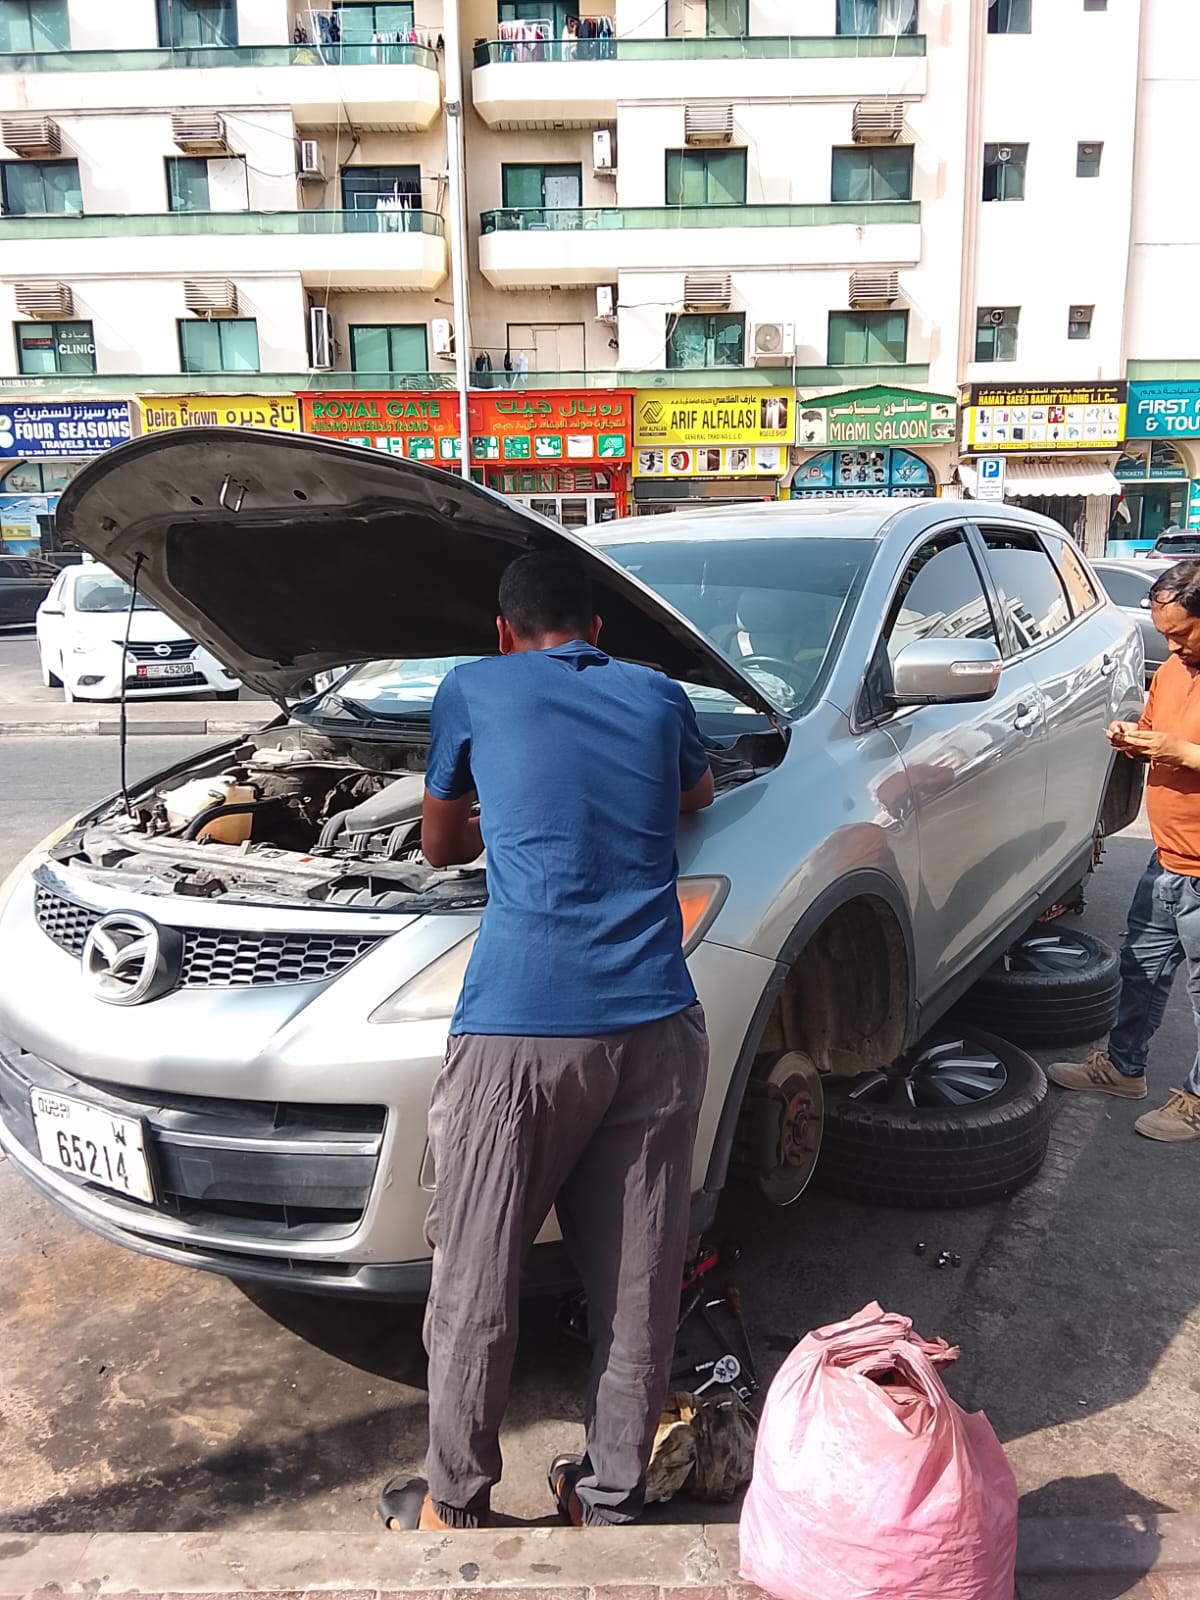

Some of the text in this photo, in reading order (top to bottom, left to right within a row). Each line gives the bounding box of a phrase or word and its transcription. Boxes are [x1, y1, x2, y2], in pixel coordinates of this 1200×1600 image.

[59, 344, 95, 354] CLINIC
[978, 395, 1005, 405] HAMAD
[1006, 394, 1029, 404] SAEED
[1030, 394, 1057, 404] BAKHIT
[1059, 393, 1089, 403] TRADING
[1138, 399, 1190, 414] FIRST
[14, 405, 128, 422] فور سيزنز للسفريات
[146, 407, 218, 427] Deira Crown
[270, 405, 295, 428] تاج
[311, 400, 440, 418] ROYAL GATE
[495, 399, 622, 418] رويال جيت
[829, 398, 928, 422] صالون ميامي
[310, 420, 347, 432] BUILDING
[348, 420, 391, 432] MATERIALS
[393, 421, 429, 432] TRADING
[671, 409, 756, 430] ARIF ALFALASI
[1146, 417, 1159, 431] &
[14, 421, 131, 439] FOUR SEASONS
[829, 420, 928, 441] MIAMI SALOON
[40, 440, 84, 449] TRAVELS
[164, 664, 191, 673] 45208
[111, 1121, 127, 1147] W
[57, 1130, 130, 1190] 65214
